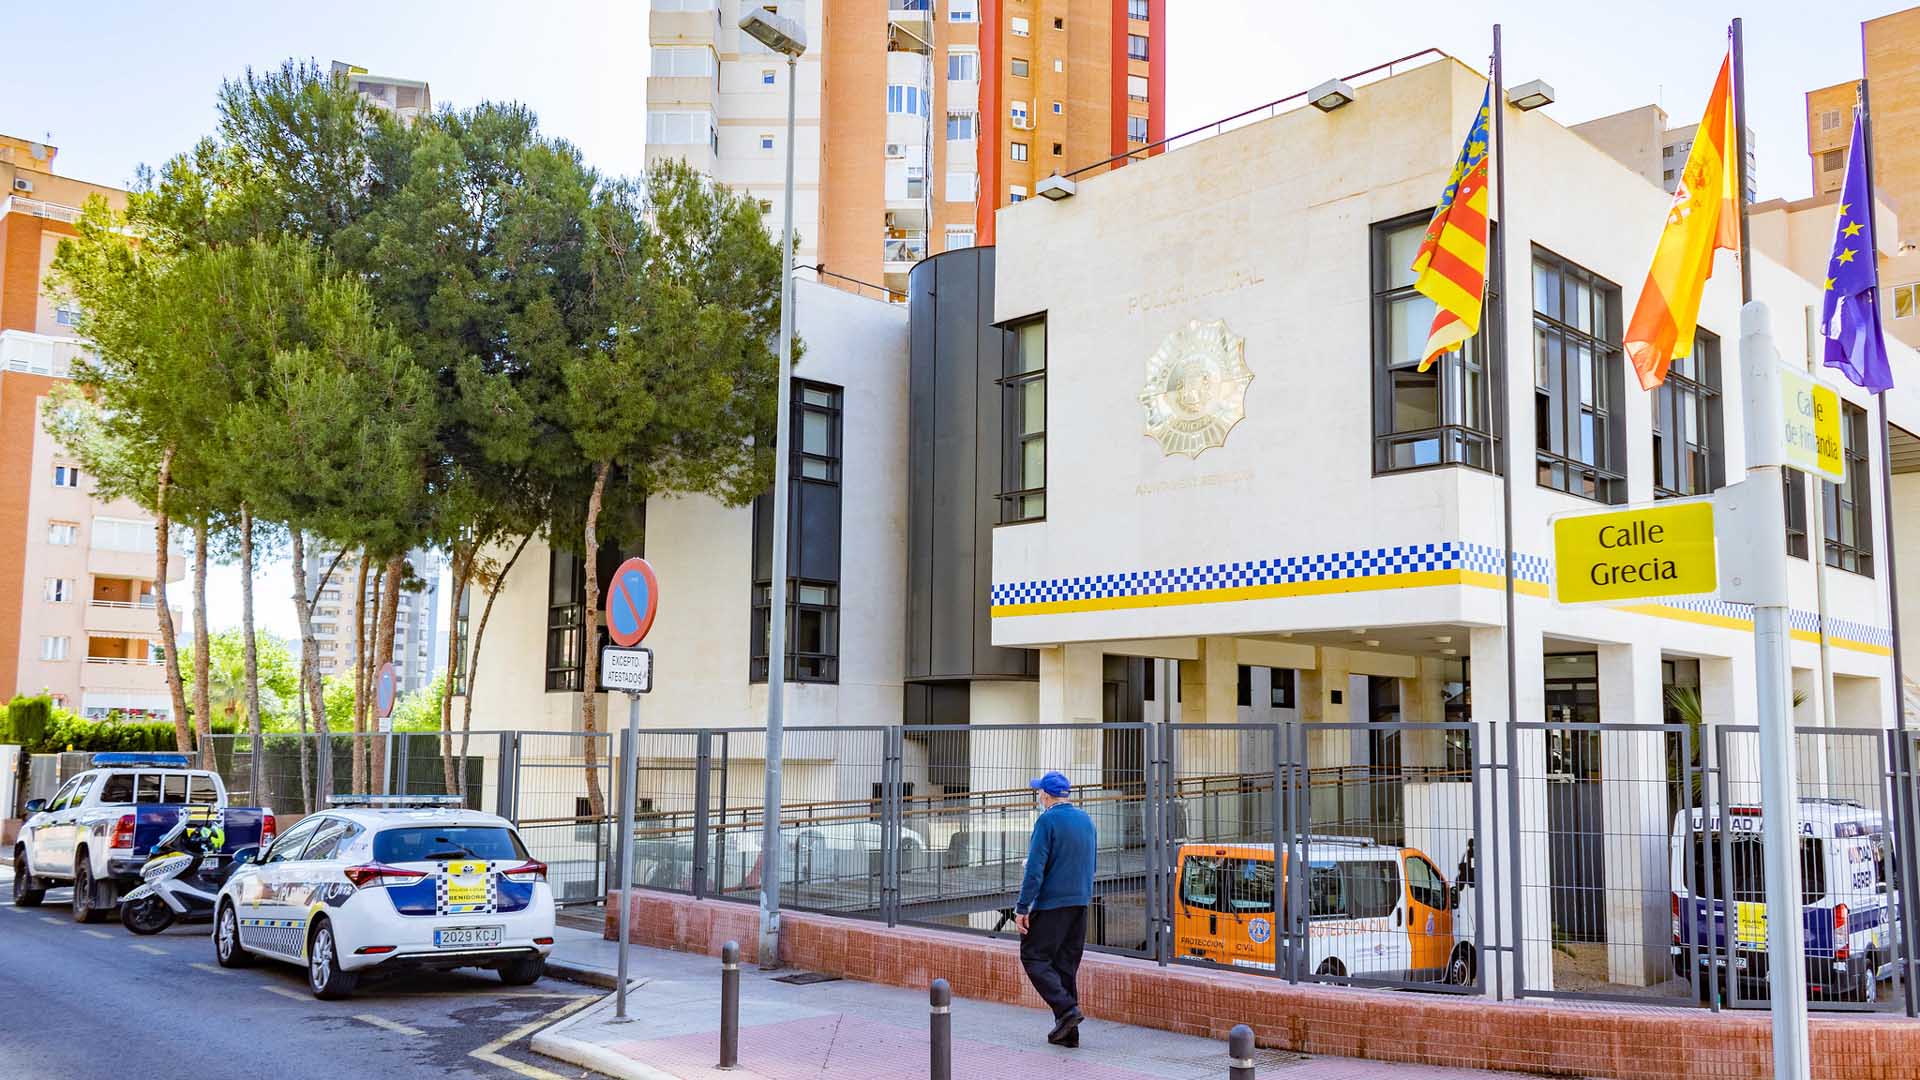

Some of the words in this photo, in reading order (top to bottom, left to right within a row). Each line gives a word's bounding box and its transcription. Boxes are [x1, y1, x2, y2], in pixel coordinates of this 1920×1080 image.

[1797, 391, 1824, 422] Cale
[1799, 425, 1838, 460] Finandia
[1598, 520, 1664, 549] Calle
[1590, 557, 1678, 586] Grecia
[611, 655, 640, 668] EXCEPTO
[607, 671, 642, 685] ATESTADOS
[1693, 817, 1752, 831] UNIAD
[443, 931, 472, 943] 2029
[475, 929, 497, 942] KCJ
[1309, 920, 1367, 938] ROTECCION
